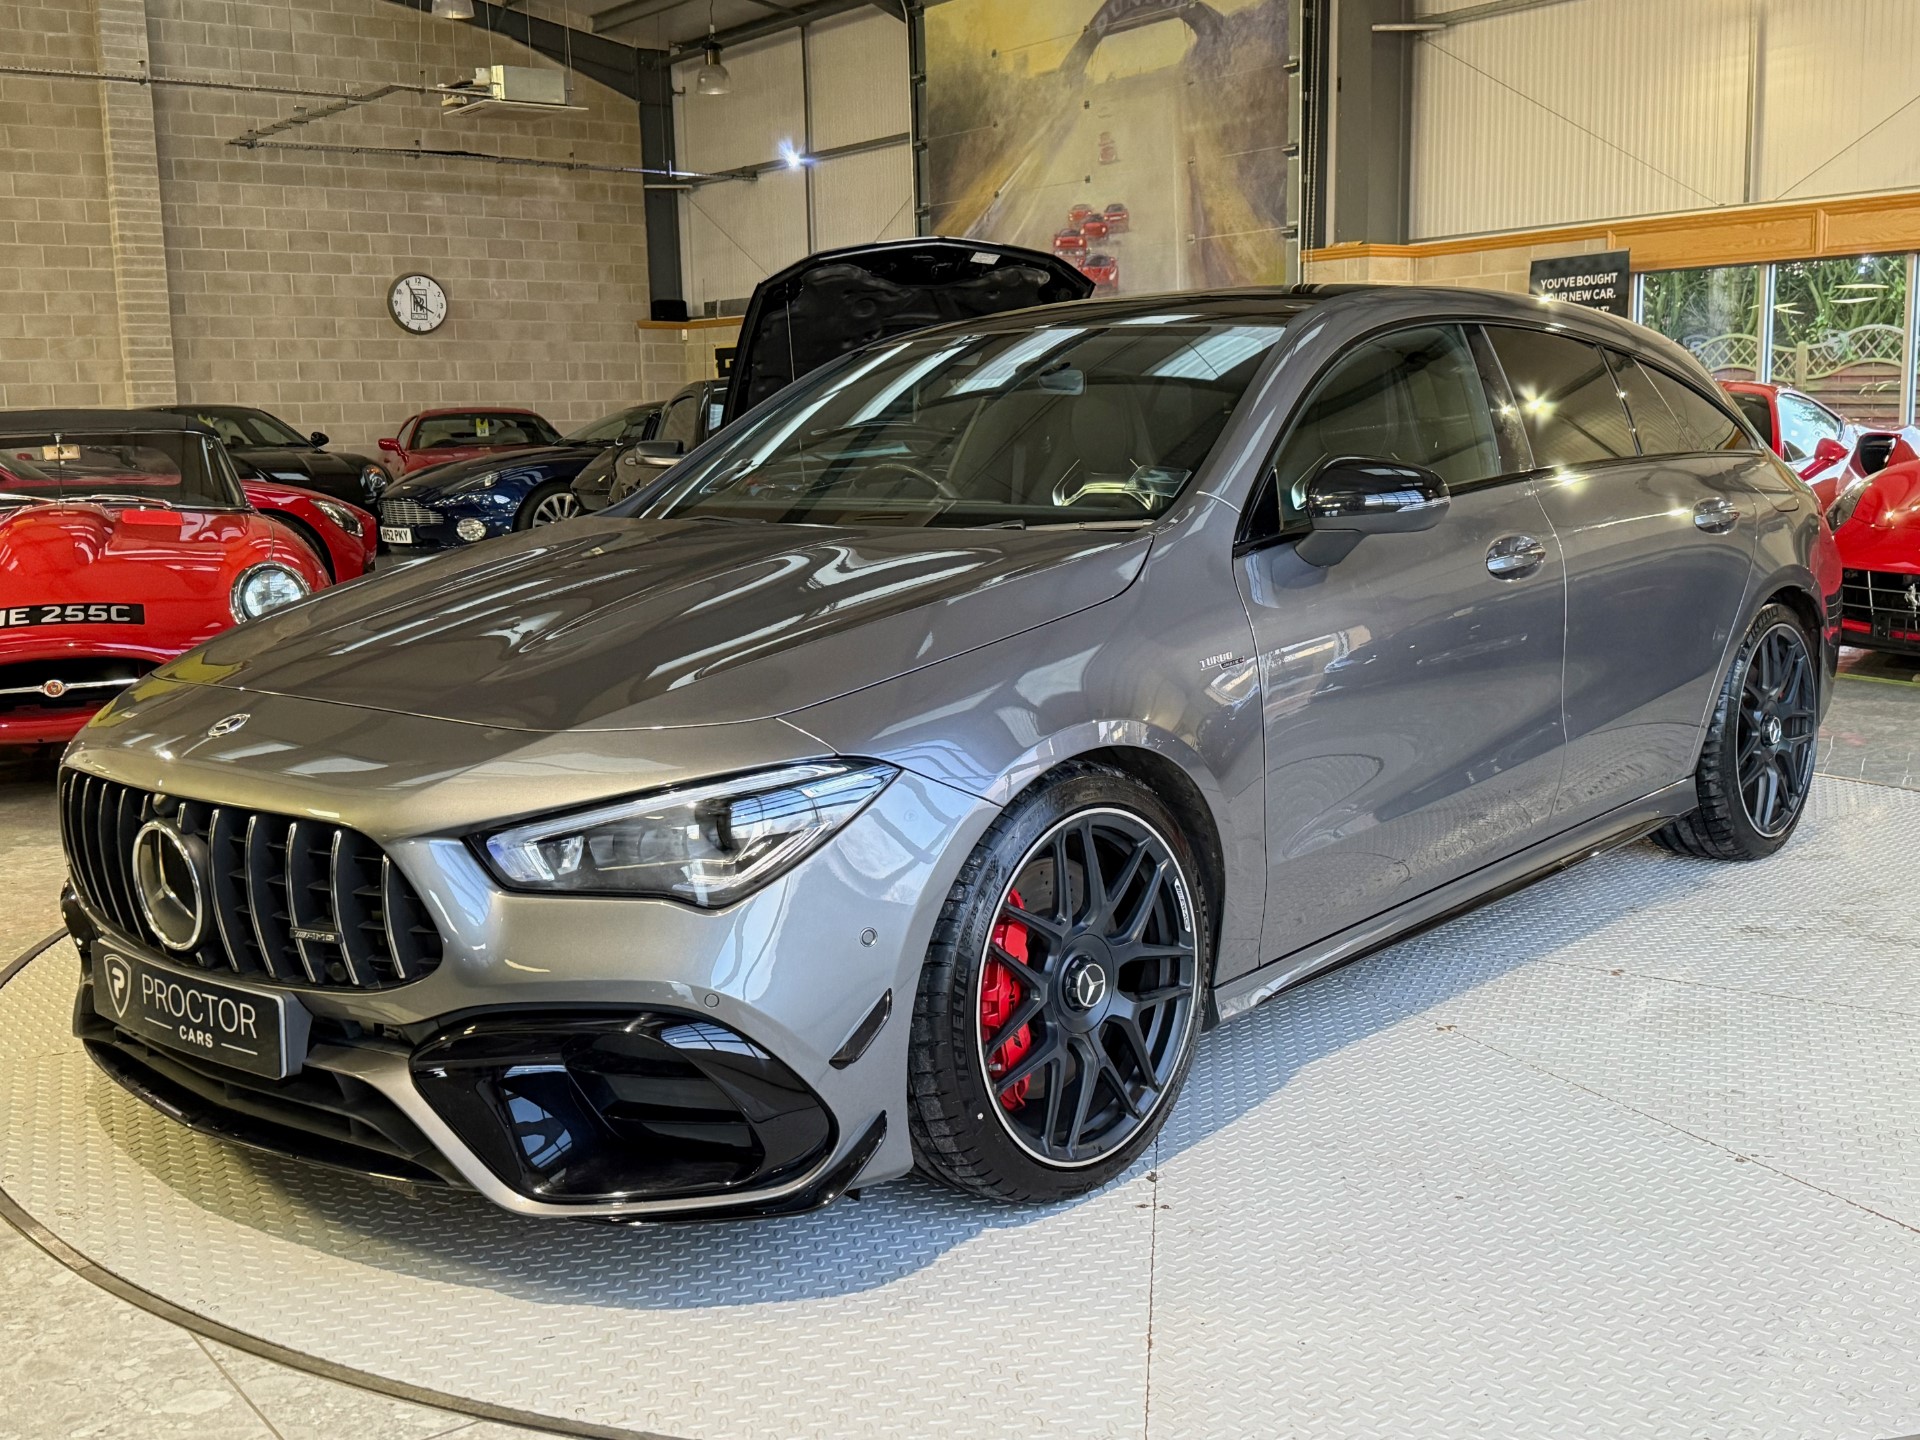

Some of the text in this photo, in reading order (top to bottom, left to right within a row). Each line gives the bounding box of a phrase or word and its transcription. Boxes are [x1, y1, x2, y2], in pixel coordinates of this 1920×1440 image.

[1540, 272, 1618, 290] YOU'VE BOUGHT
[1568, 289, 1593, 302] NEW
[1592, 287, 1617, 299] CAR.
[40, 605, 131, 623] 255C
[141, 973, 258, 1039] PROCTOR
[178, 1024, 214, 1048] CARS
